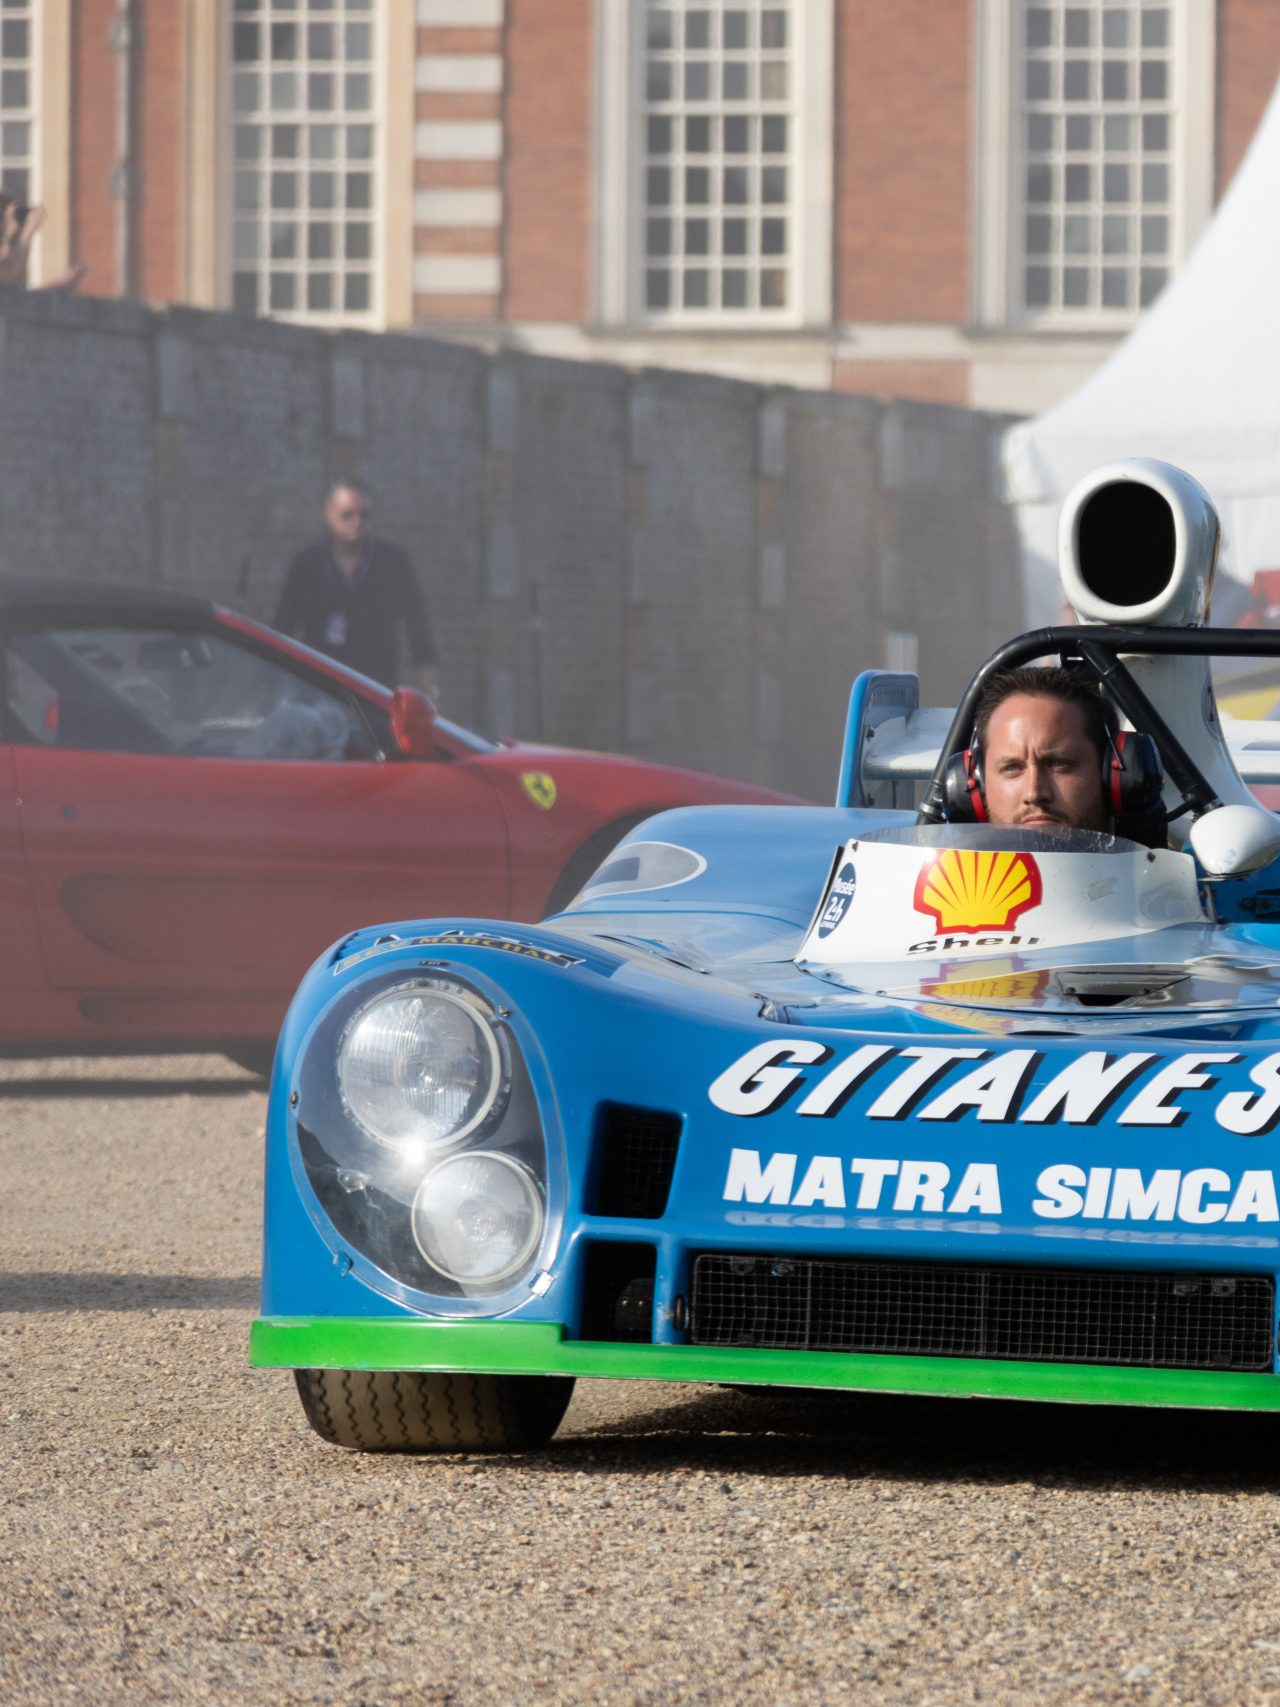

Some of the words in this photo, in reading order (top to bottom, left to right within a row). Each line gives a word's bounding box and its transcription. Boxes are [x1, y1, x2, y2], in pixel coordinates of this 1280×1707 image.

[906, 935, 1040, 955] Shell
[723, 1148, 1003, 1215] MATRA
[1032, 1163, 1280, 1223] SIMCA
